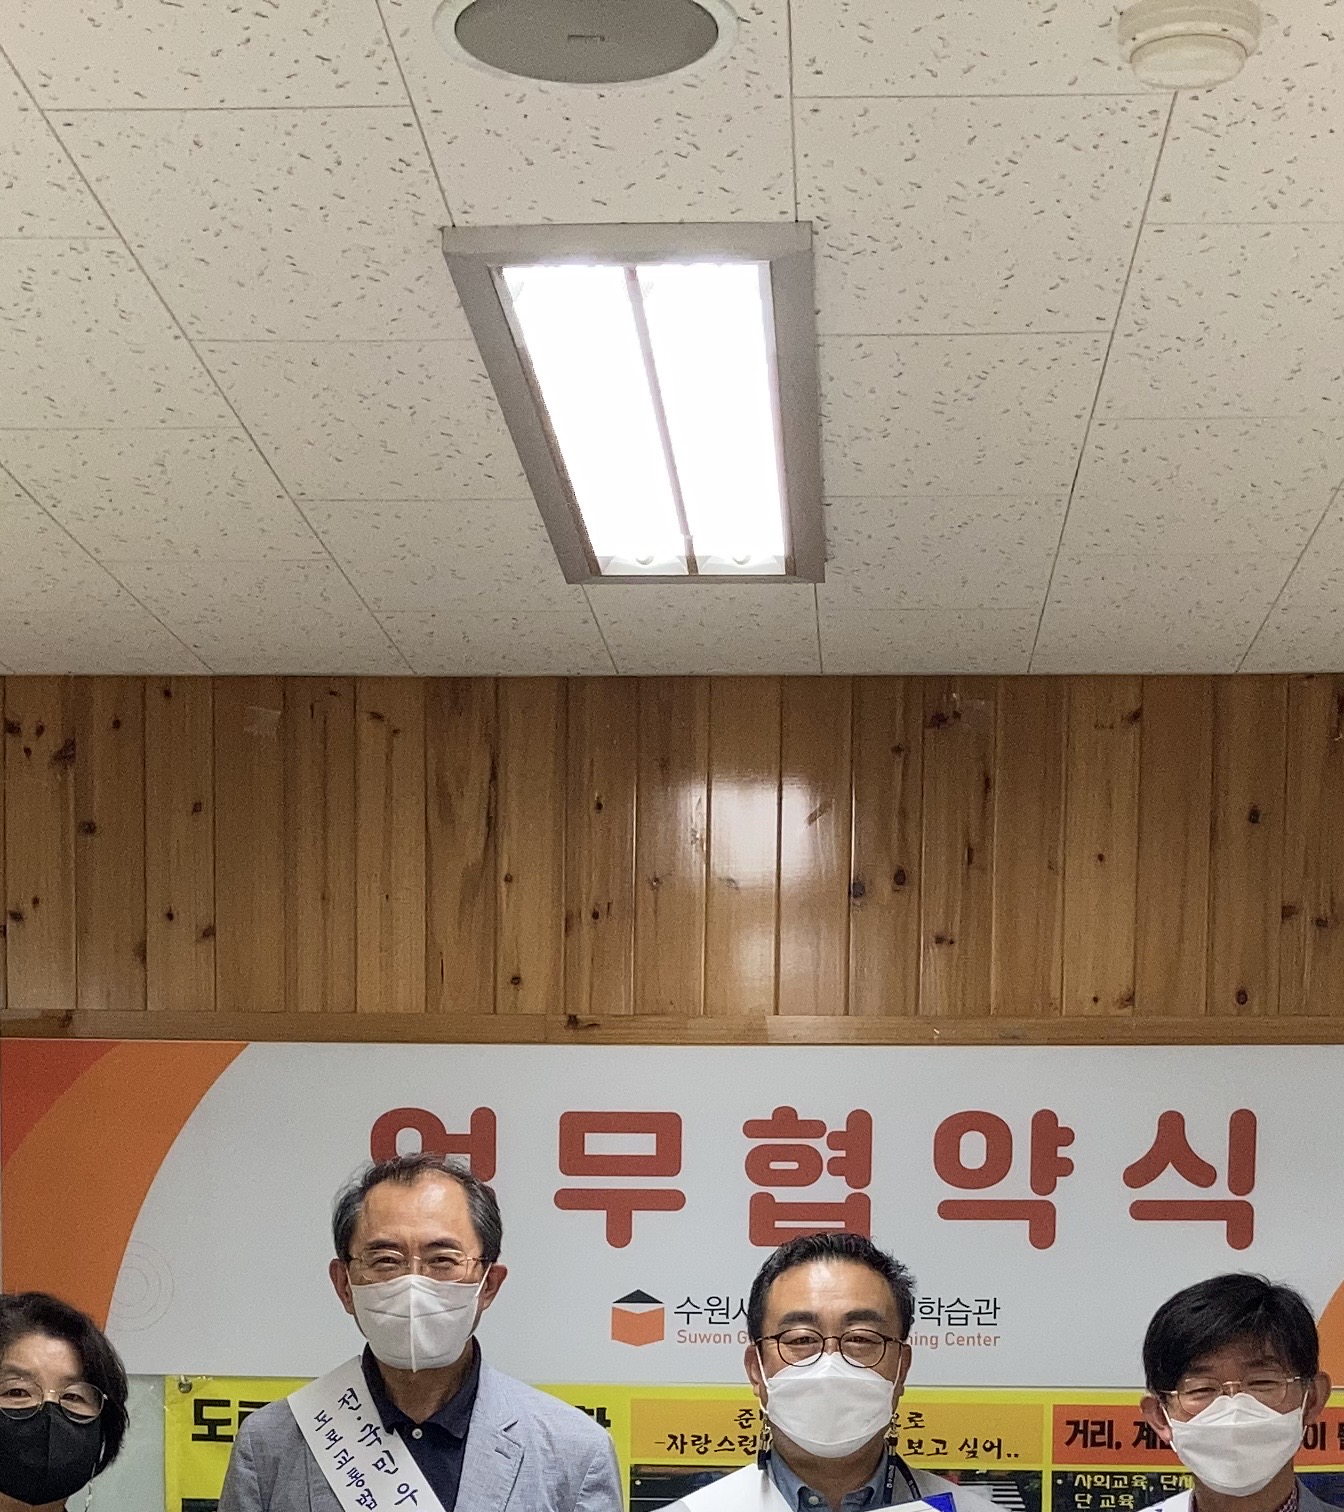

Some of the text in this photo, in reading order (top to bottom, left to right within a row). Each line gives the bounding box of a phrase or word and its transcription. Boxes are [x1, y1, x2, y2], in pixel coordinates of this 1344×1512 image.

[911, 1296, 1001, 1326] 학습관
[677, 1329, 732, 1344] Suwon
[945, 1332, 1000, 1347] Center
[1064, 1419, 1122, 1450] 거리,
[903, 1438, 949, 1456] 보고
[314, 1410, 378, 1509] 도로교통법
[1100, 1494, 1135, 1510] 교육
